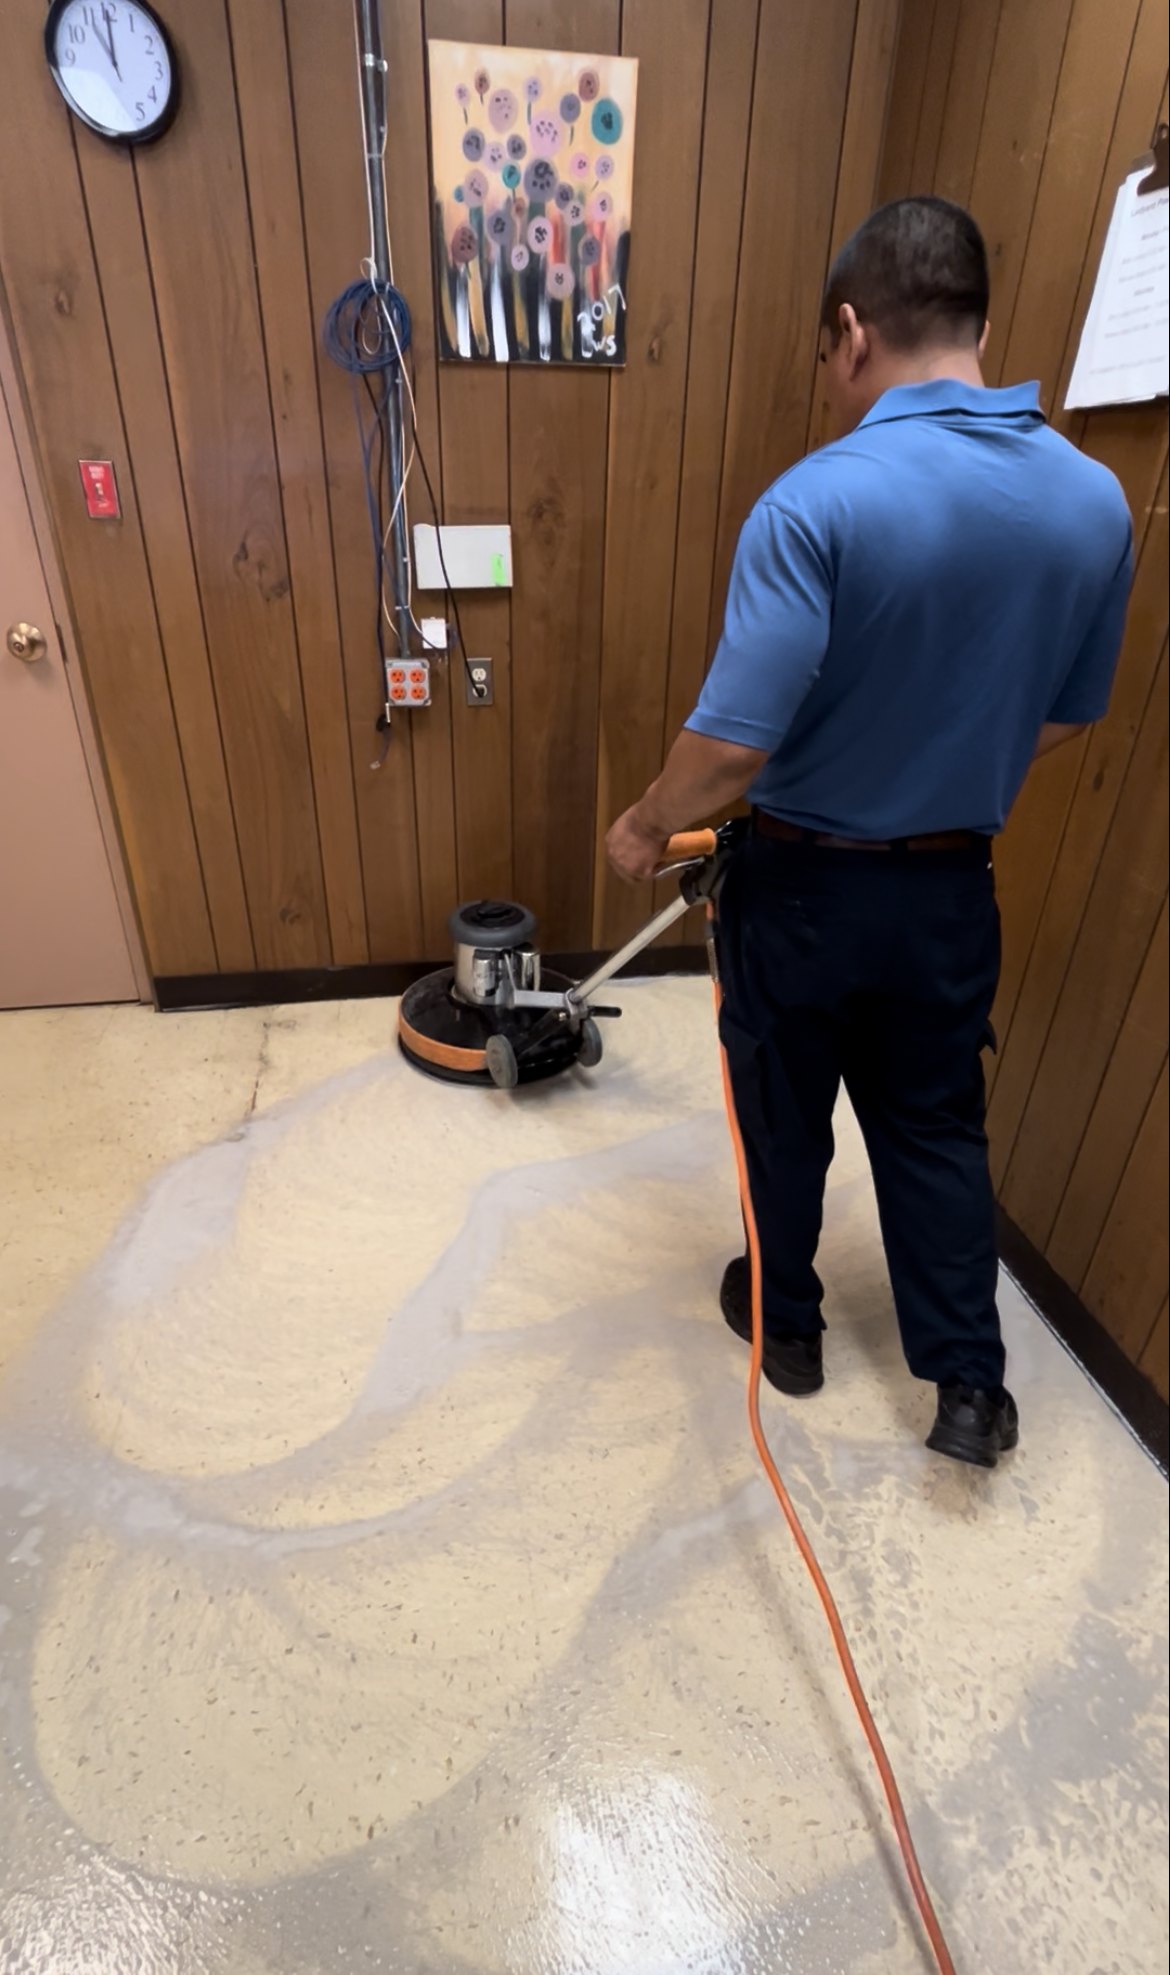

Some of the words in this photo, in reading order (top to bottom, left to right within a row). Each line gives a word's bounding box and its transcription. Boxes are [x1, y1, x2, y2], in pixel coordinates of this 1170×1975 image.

[129, 13, 135, 33] 1
[69, 23, 86, 44] 10
[144, 35, 154, 55] 2
[65, 48, 76, 65] 9
[154, 60, 164, 81] 3
[147, 85, 157, 104] 4
[135, 102, 146, 122] 5
